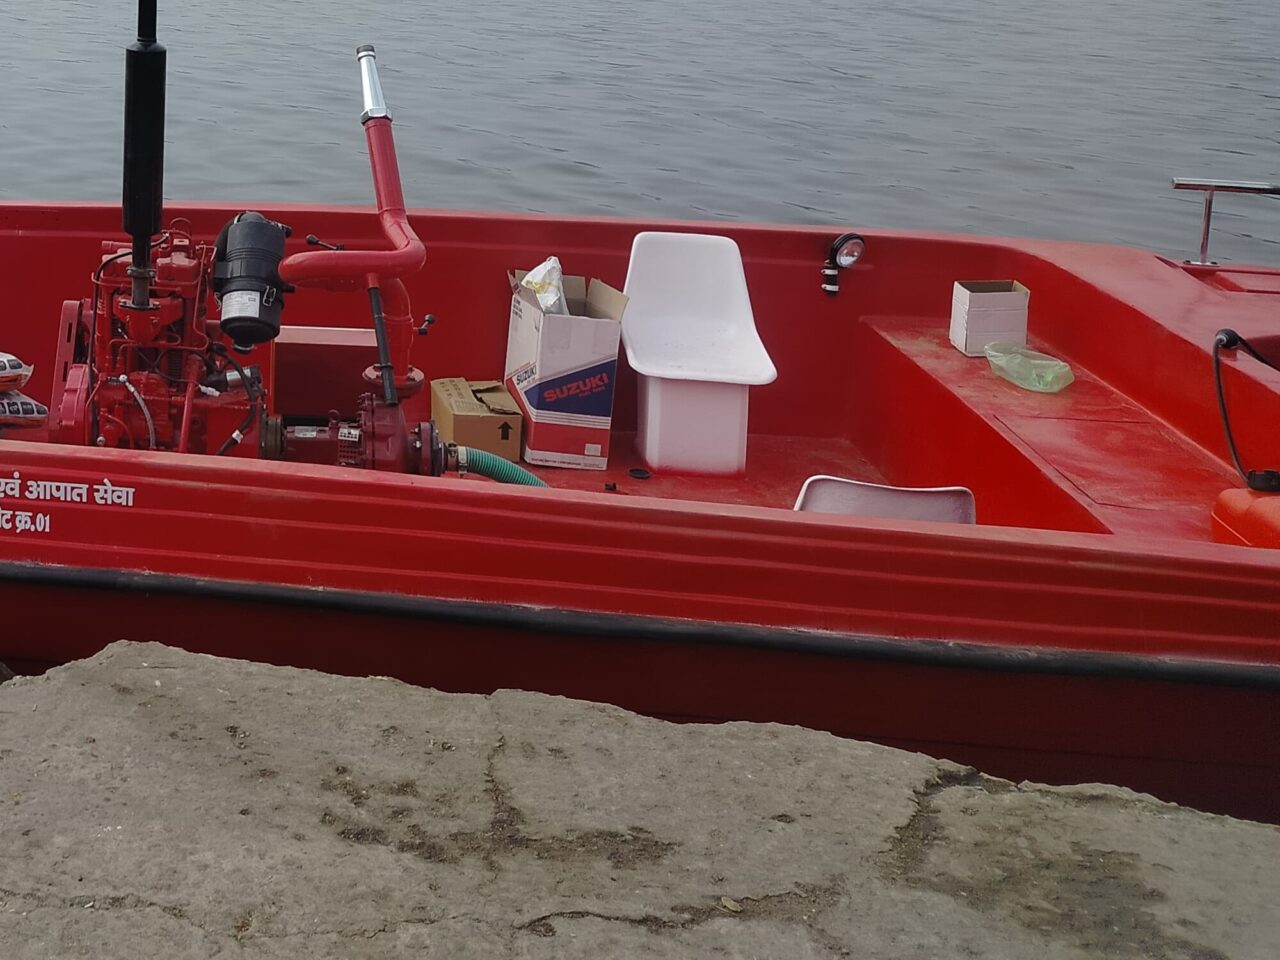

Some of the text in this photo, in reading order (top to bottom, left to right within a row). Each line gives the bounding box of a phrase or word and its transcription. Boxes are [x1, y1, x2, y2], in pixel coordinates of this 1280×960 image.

[516, 365, 537, 385] SUZUKI
[543, 373, 609, 402] SUZUKI
[25, 480, 89, 502] आपात
[93, 478, 135, 506] सेवा
